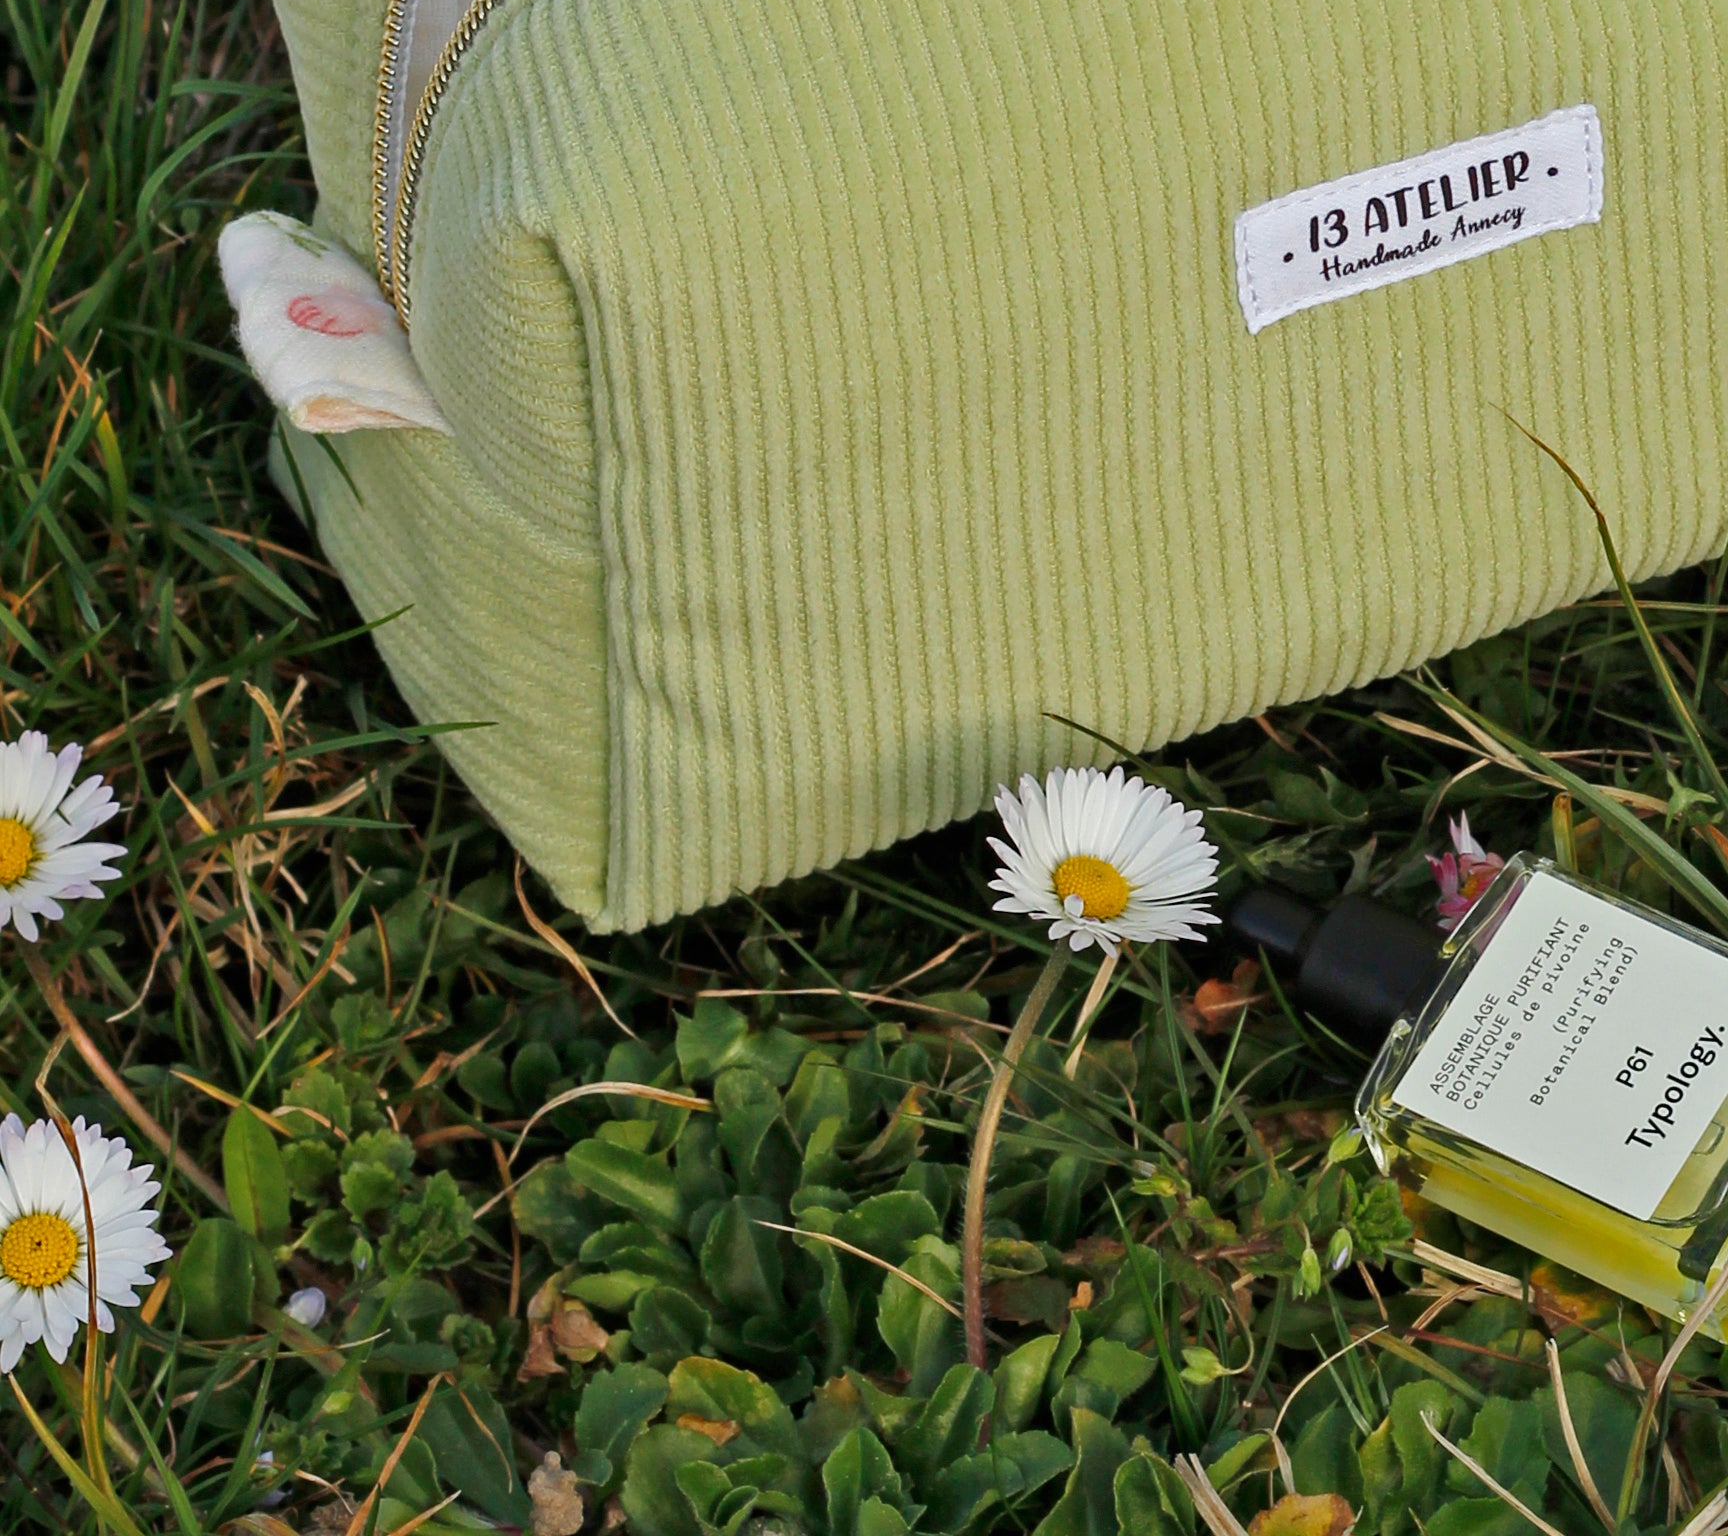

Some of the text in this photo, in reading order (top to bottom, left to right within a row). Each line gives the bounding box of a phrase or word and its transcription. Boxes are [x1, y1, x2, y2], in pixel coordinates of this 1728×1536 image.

[1309, 150, 1530, 252] 13 ATELIER
[1319, 205, 1526, 281] Handmade Annecy
[1446, 917, 1570, 1102] BOTANIQUE PURIFIANT
[1464, 923, 1590, 1110] Cellules de pivoine
[1529, 946, 1638, 1106] Botanical Blend)
[1552, 936, 1623, 1034] (Purifying
[1430, 993, 1500, 1094] ASSEMBLAGE
[1615, 1045, 1654, 1088] P61
[1624, 1026, 1725, 1148] Typology.
